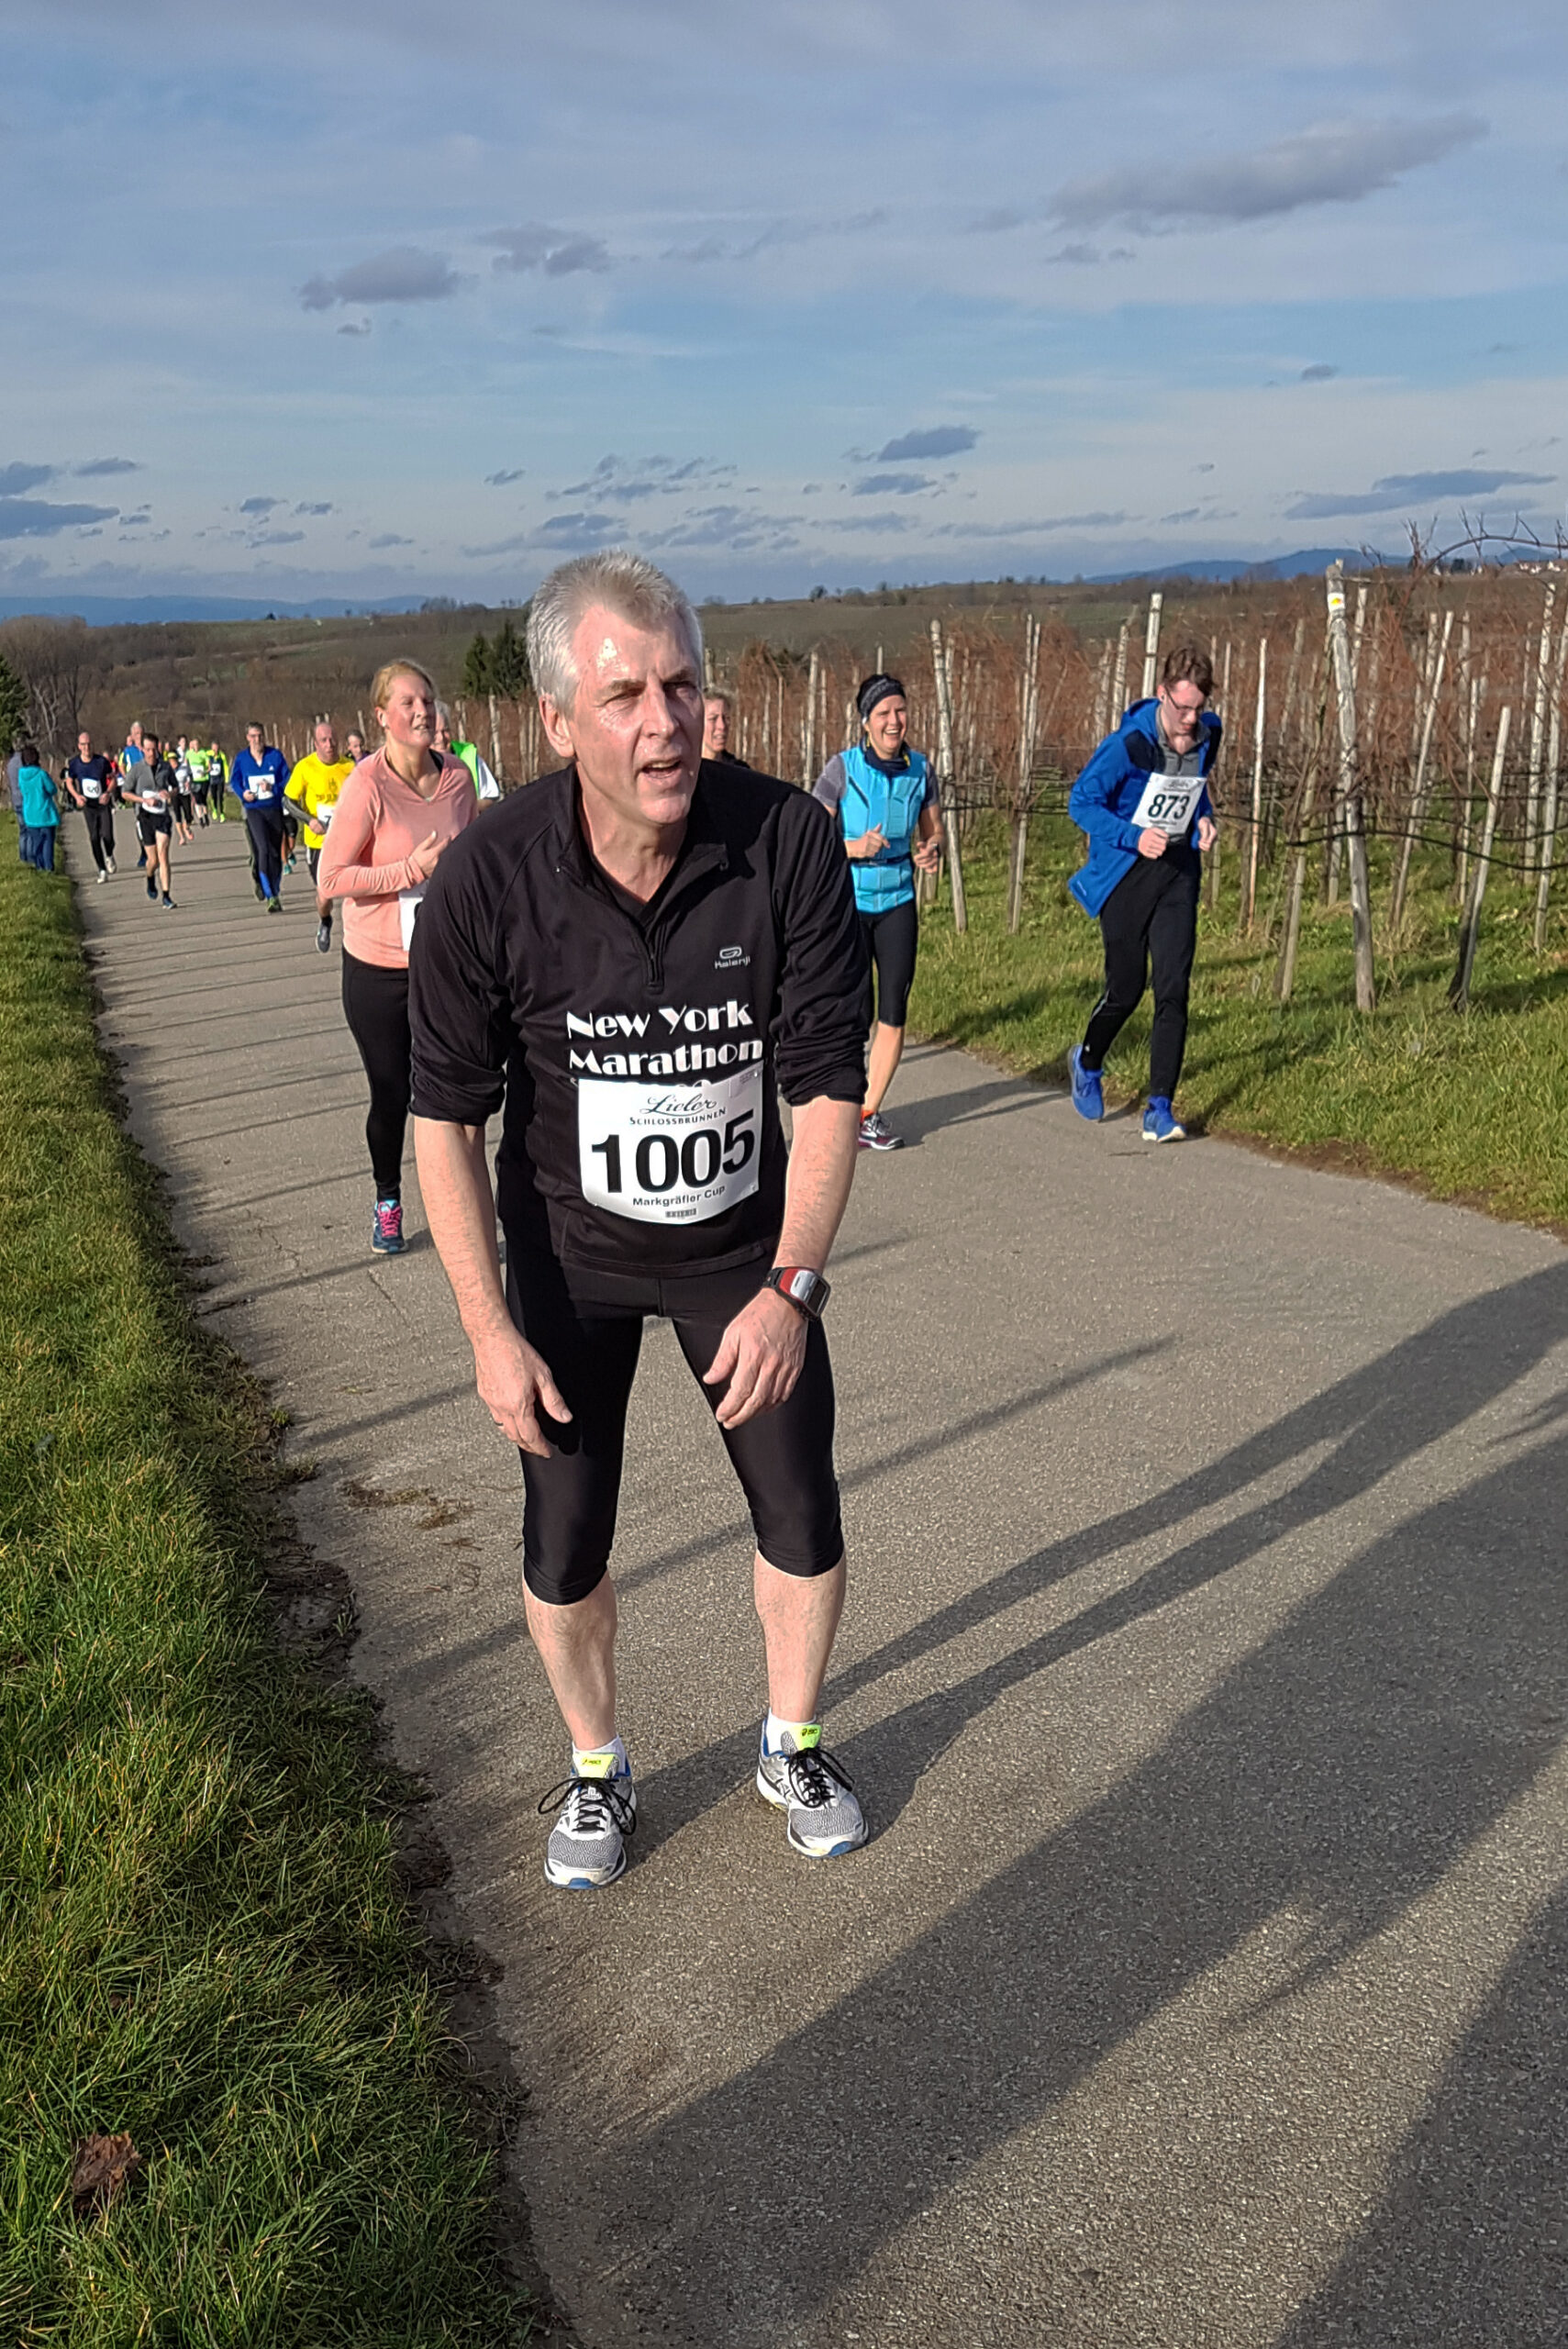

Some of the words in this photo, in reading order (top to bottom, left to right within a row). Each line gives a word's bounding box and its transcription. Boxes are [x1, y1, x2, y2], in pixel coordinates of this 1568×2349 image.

[1148, 794, 1190, 819] 873
[566, 1010, 651, 1040] New
[658, 1000, 753, 1035] York
[569, 1040, 763, 1075] Marathon
[591, 1108, 755, 1193] 1005
[633, 1194, 701, 1207] Markgräfler
[704, 1186, 726, 1198] Cup
